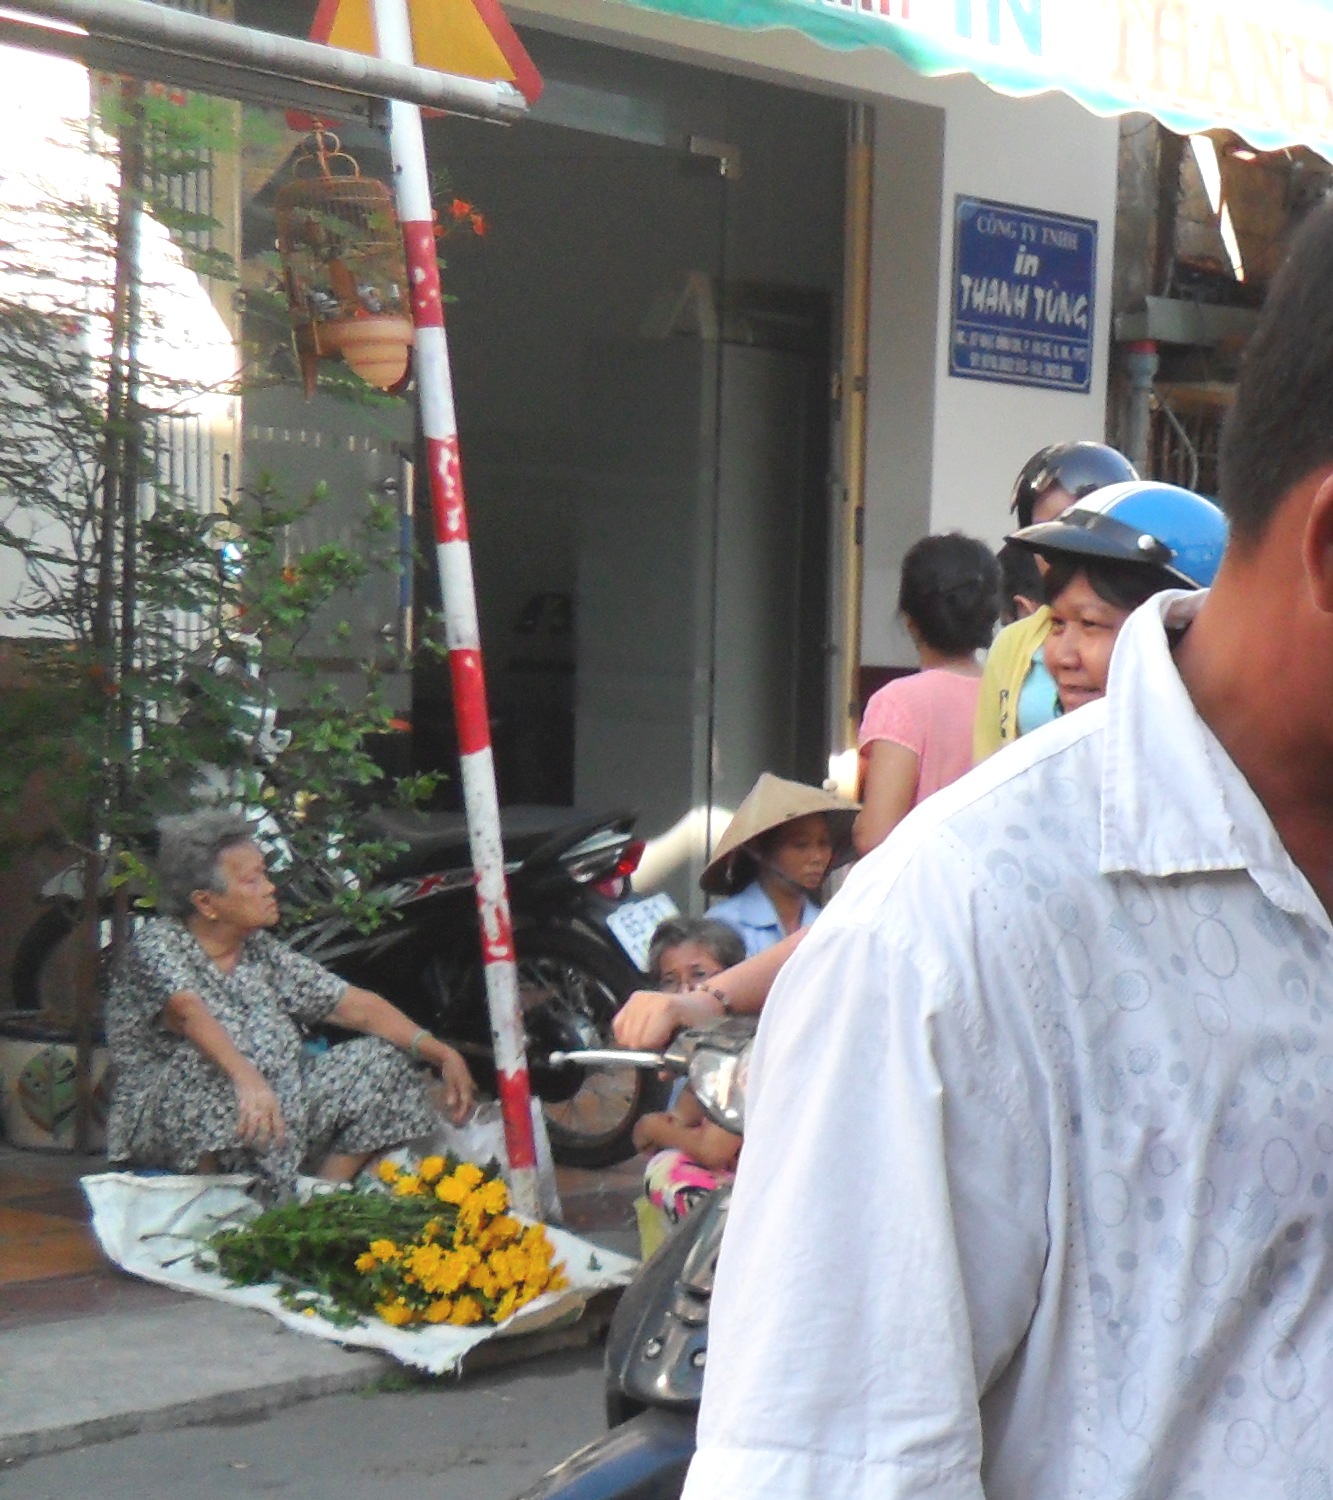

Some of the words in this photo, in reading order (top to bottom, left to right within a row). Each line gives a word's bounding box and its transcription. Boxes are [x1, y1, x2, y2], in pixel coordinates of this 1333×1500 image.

[1012, 244, 1040, 277] in
[960, 273, 1030, 319] THANH
[1032, 280, 1088, 330] TÙNG
